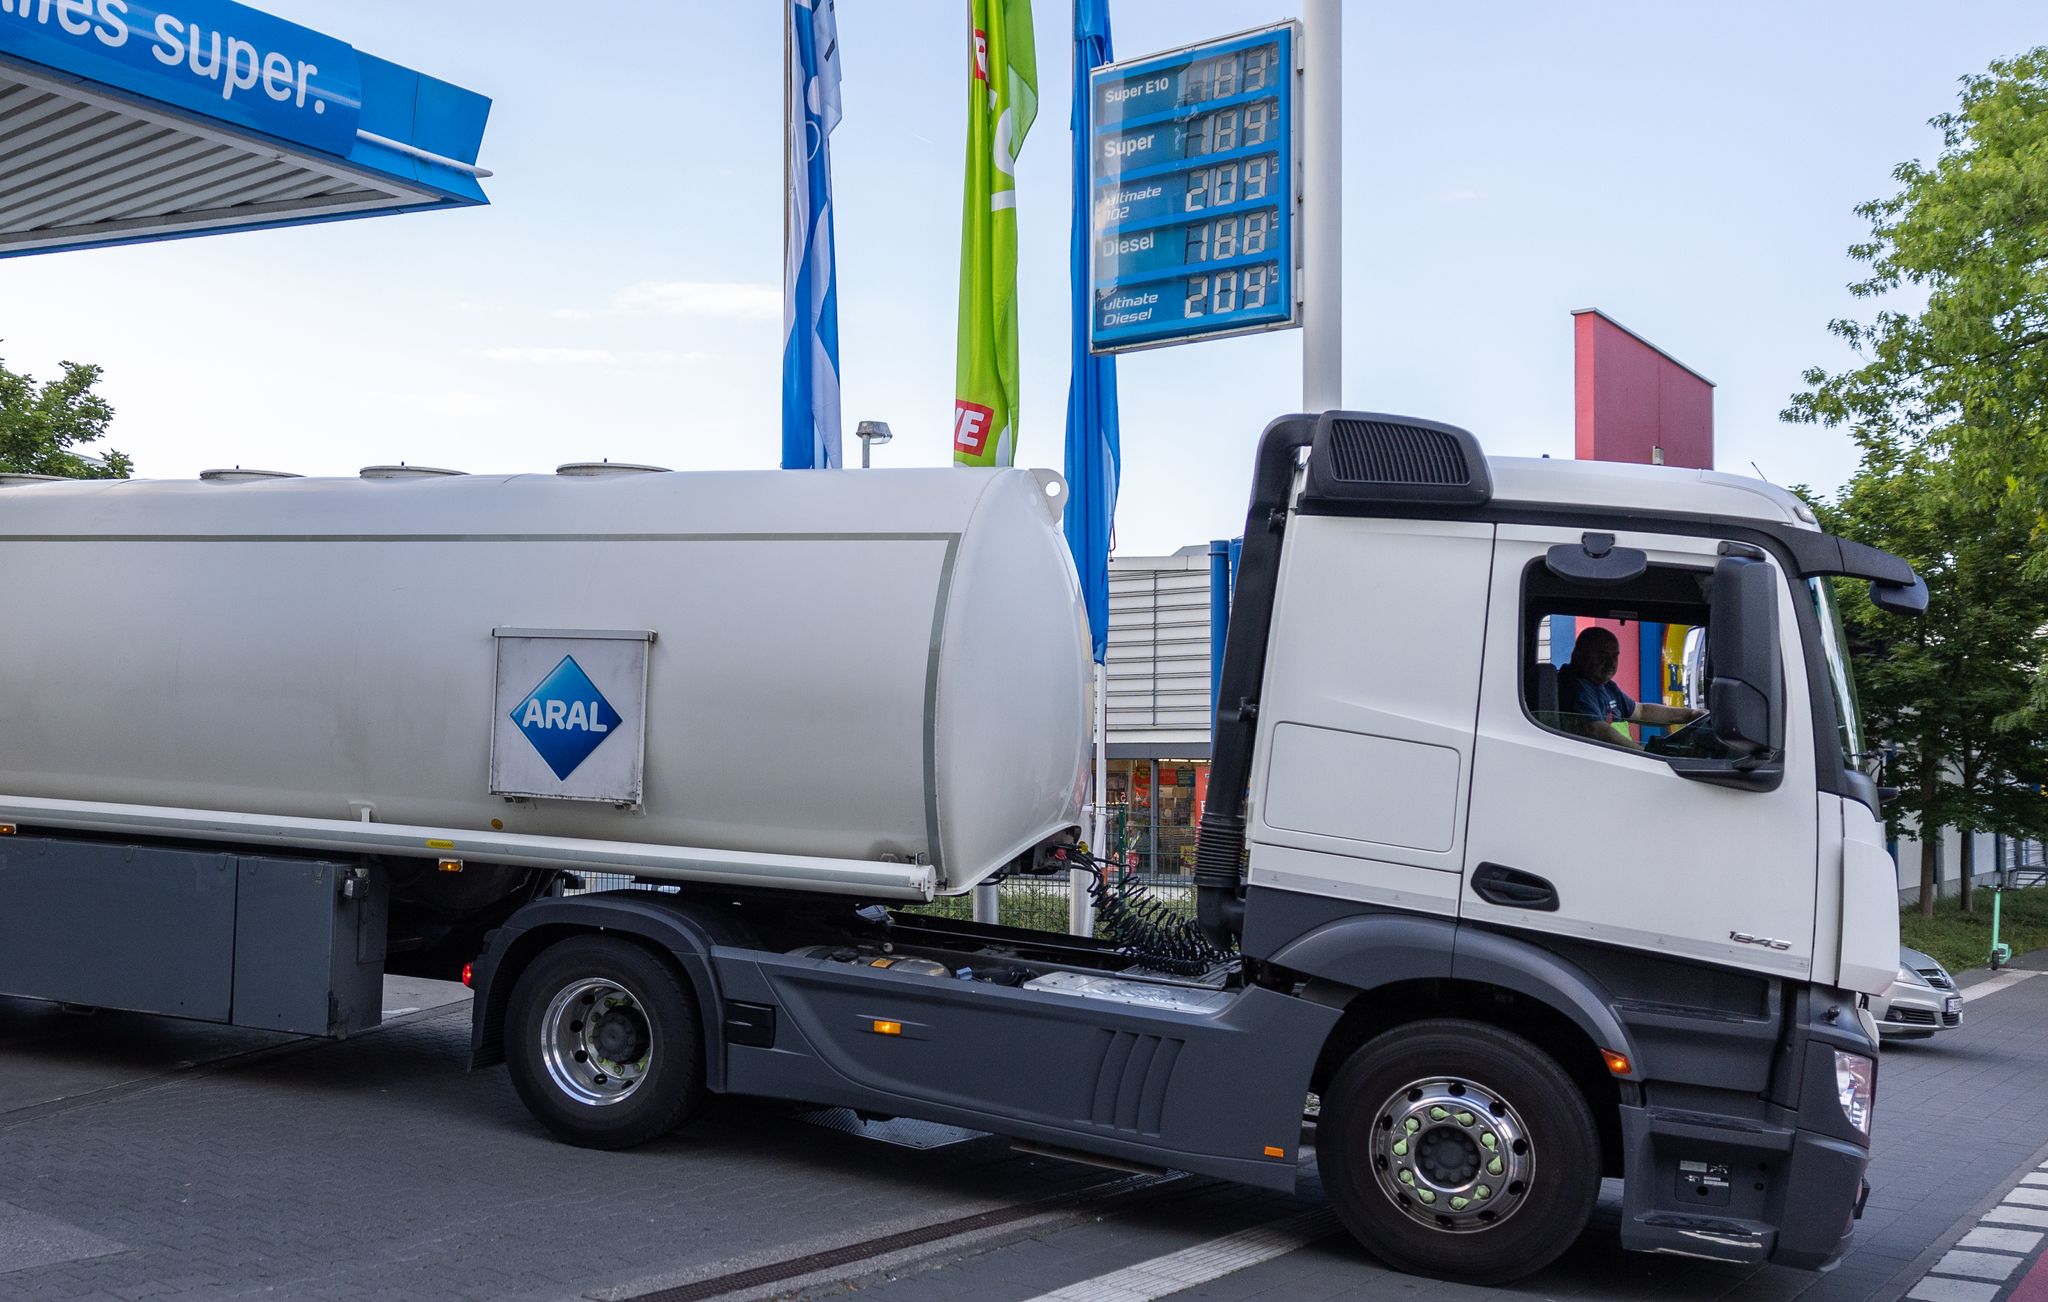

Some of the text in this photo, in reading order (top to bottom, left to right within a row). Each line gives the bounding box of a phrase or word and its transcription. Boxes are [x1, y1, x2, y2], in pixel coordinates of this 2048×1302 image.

[152, 13, 325, 114] super.
[1105, 85, 1143, 103] Super
[1145, 77, 1169, 94] E10
[1104, 134, 1154, 157] Super
[1103, 232, 1154, 257] Diesel
[1103, 292, 1158, 311] ultimate
[1103, 307, 1152, 326] Diesel
[522, 698, 607, 732] ARAL
